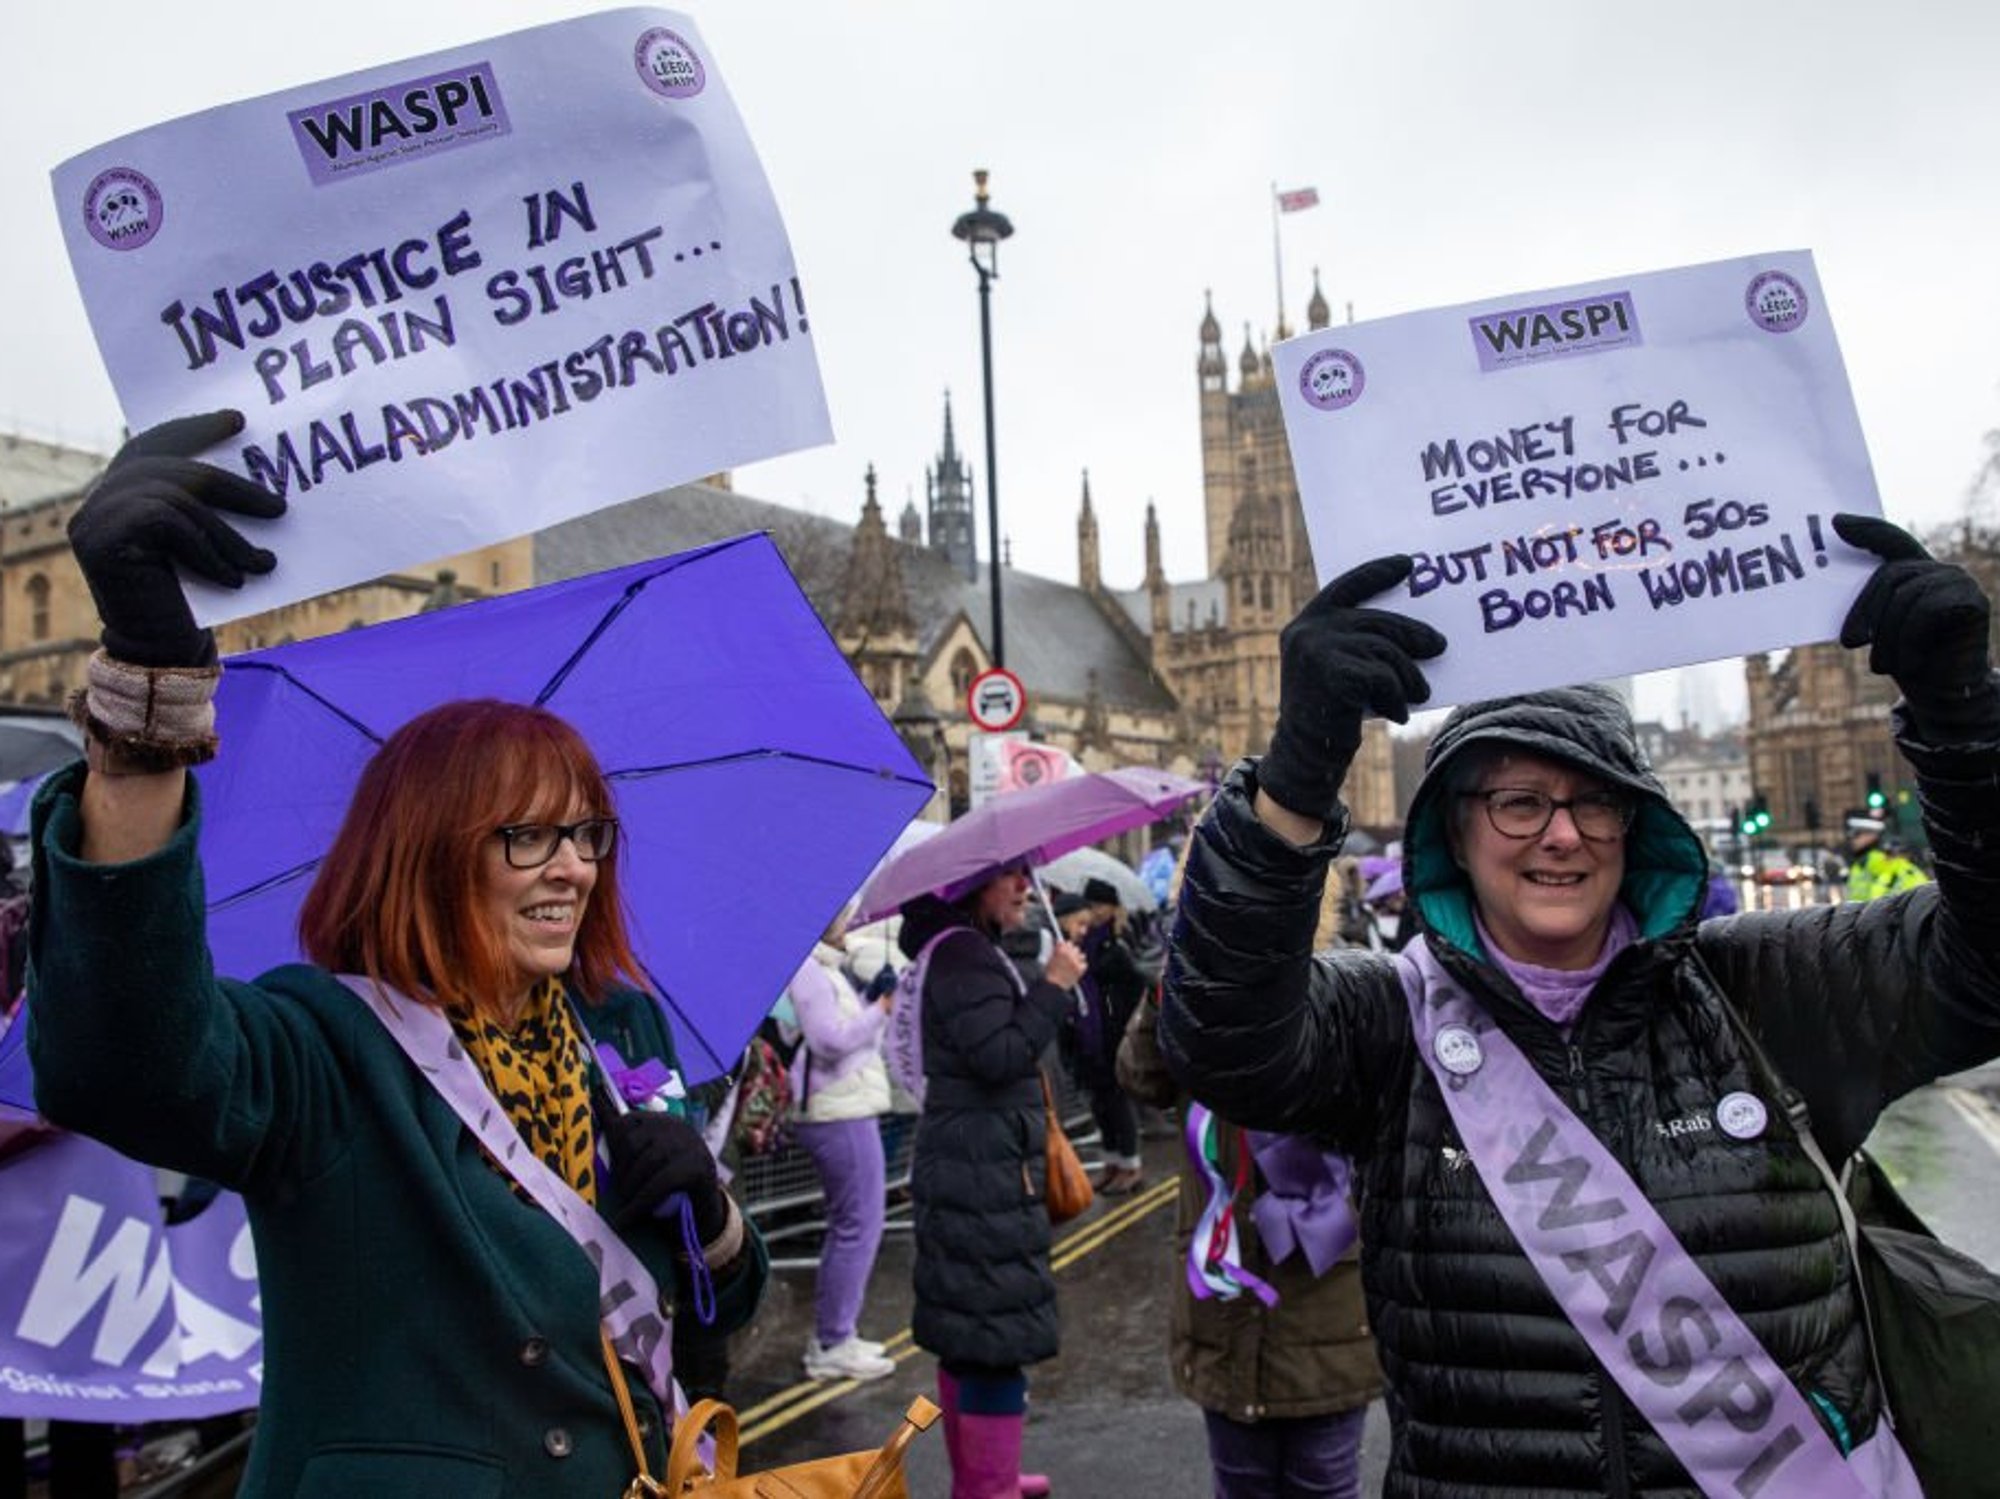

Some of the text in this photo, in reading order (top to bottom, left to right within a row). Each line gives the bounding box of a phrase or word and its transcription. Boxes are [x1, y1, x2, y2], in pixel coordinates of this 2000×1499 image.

[652, 61, 693, 75] LEEDS
[301, 74, 493, 160] WASPI
[107, 219, 149, 240] WASPI
[161, 181, 597, 371] INJUSTICE IN
[253, 225, 721, 404] PLAIN SIGHT...
[1480, 301, 1629, 353] WASPI
[242, 276, 809, 496] MALADMINISTRATION!
[1420, 400, 1707, 481] MONEY FOR
[1430, 450, 1726, 516] EVERYONE...
[1408, 499, 1769, 598] BUT NOT FOR 50s
[1478, 514, 1829, 633] BORN WOMEN!
[1669, 1115, 1712, 1138] Rab
[1502, 1118, 1806, 1498] WASPI
[0, 1366, 131, 1400] gainst
